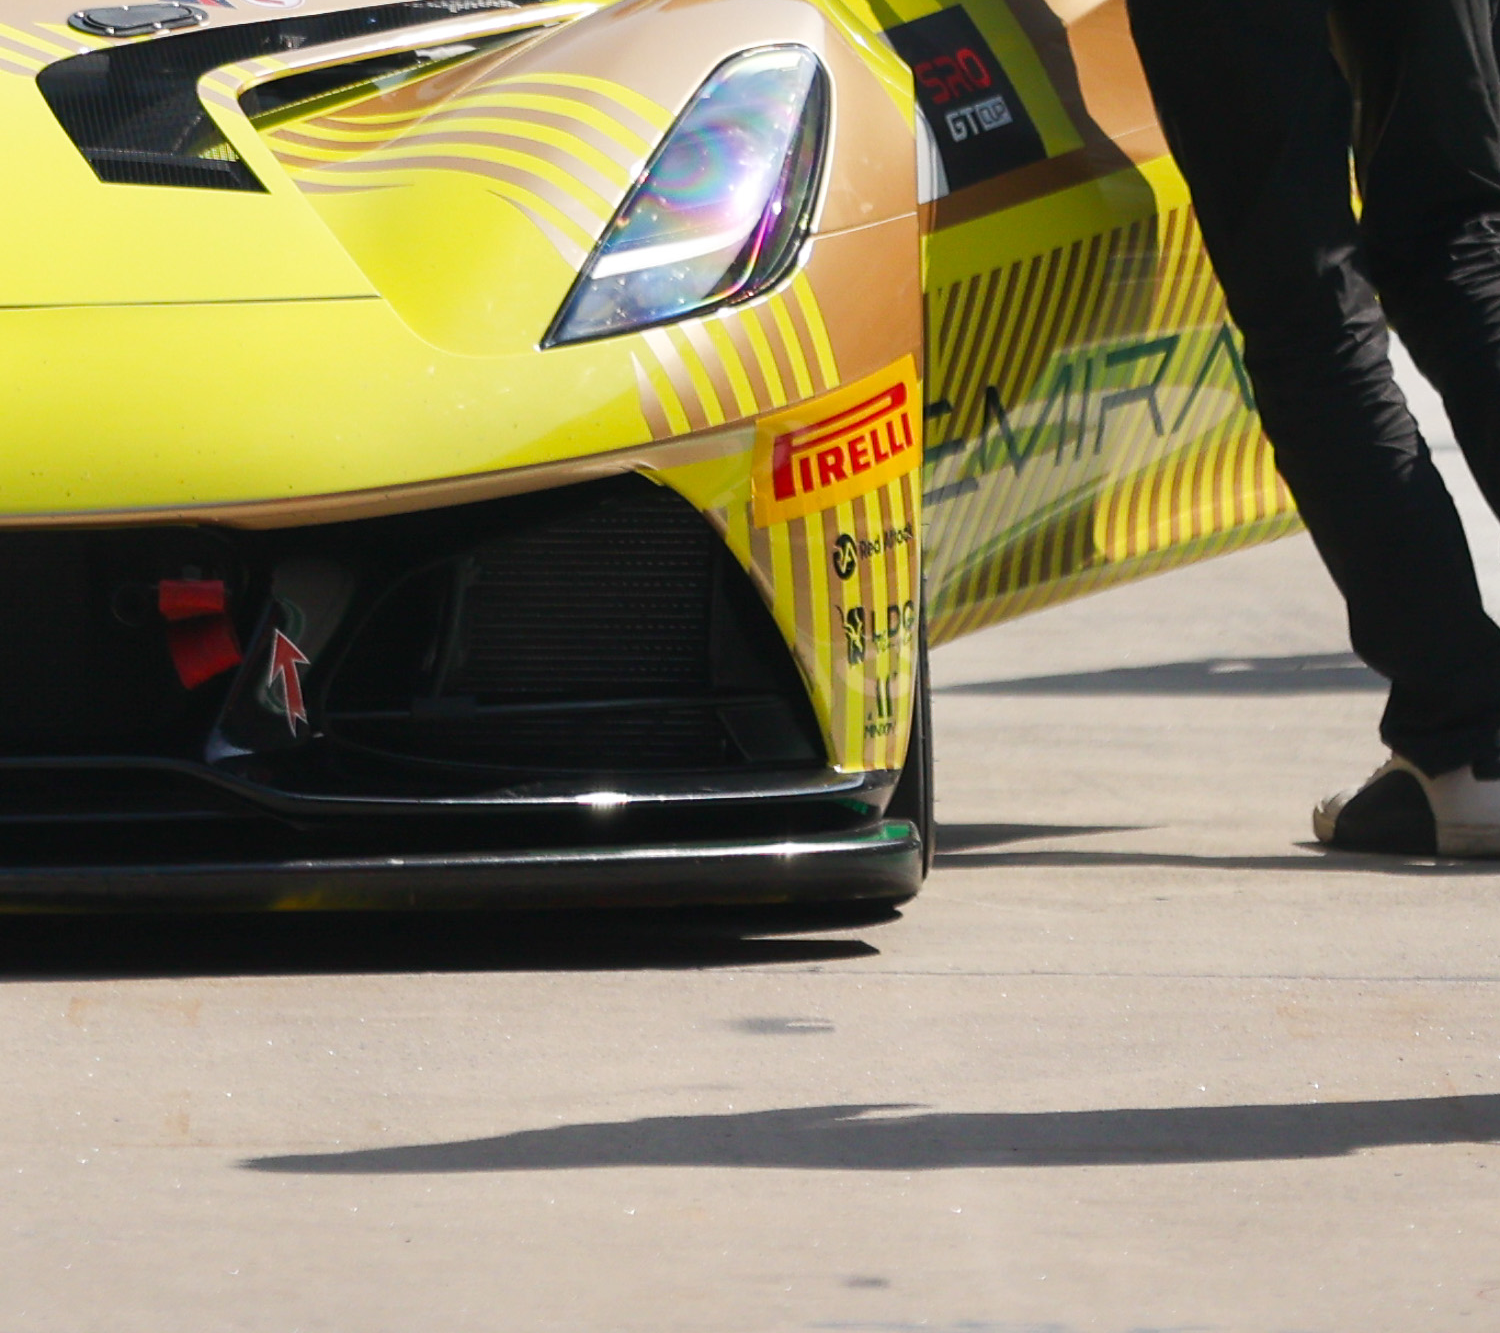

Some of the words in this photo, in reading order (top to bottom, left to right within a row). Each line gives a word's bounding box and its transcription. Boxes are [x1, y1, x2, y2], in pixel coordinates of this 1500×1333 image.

[913, 47, 993, 105] SRO
[944, 106, 980, 143] GT
[773, 381, 914, 502] PIRELLI
